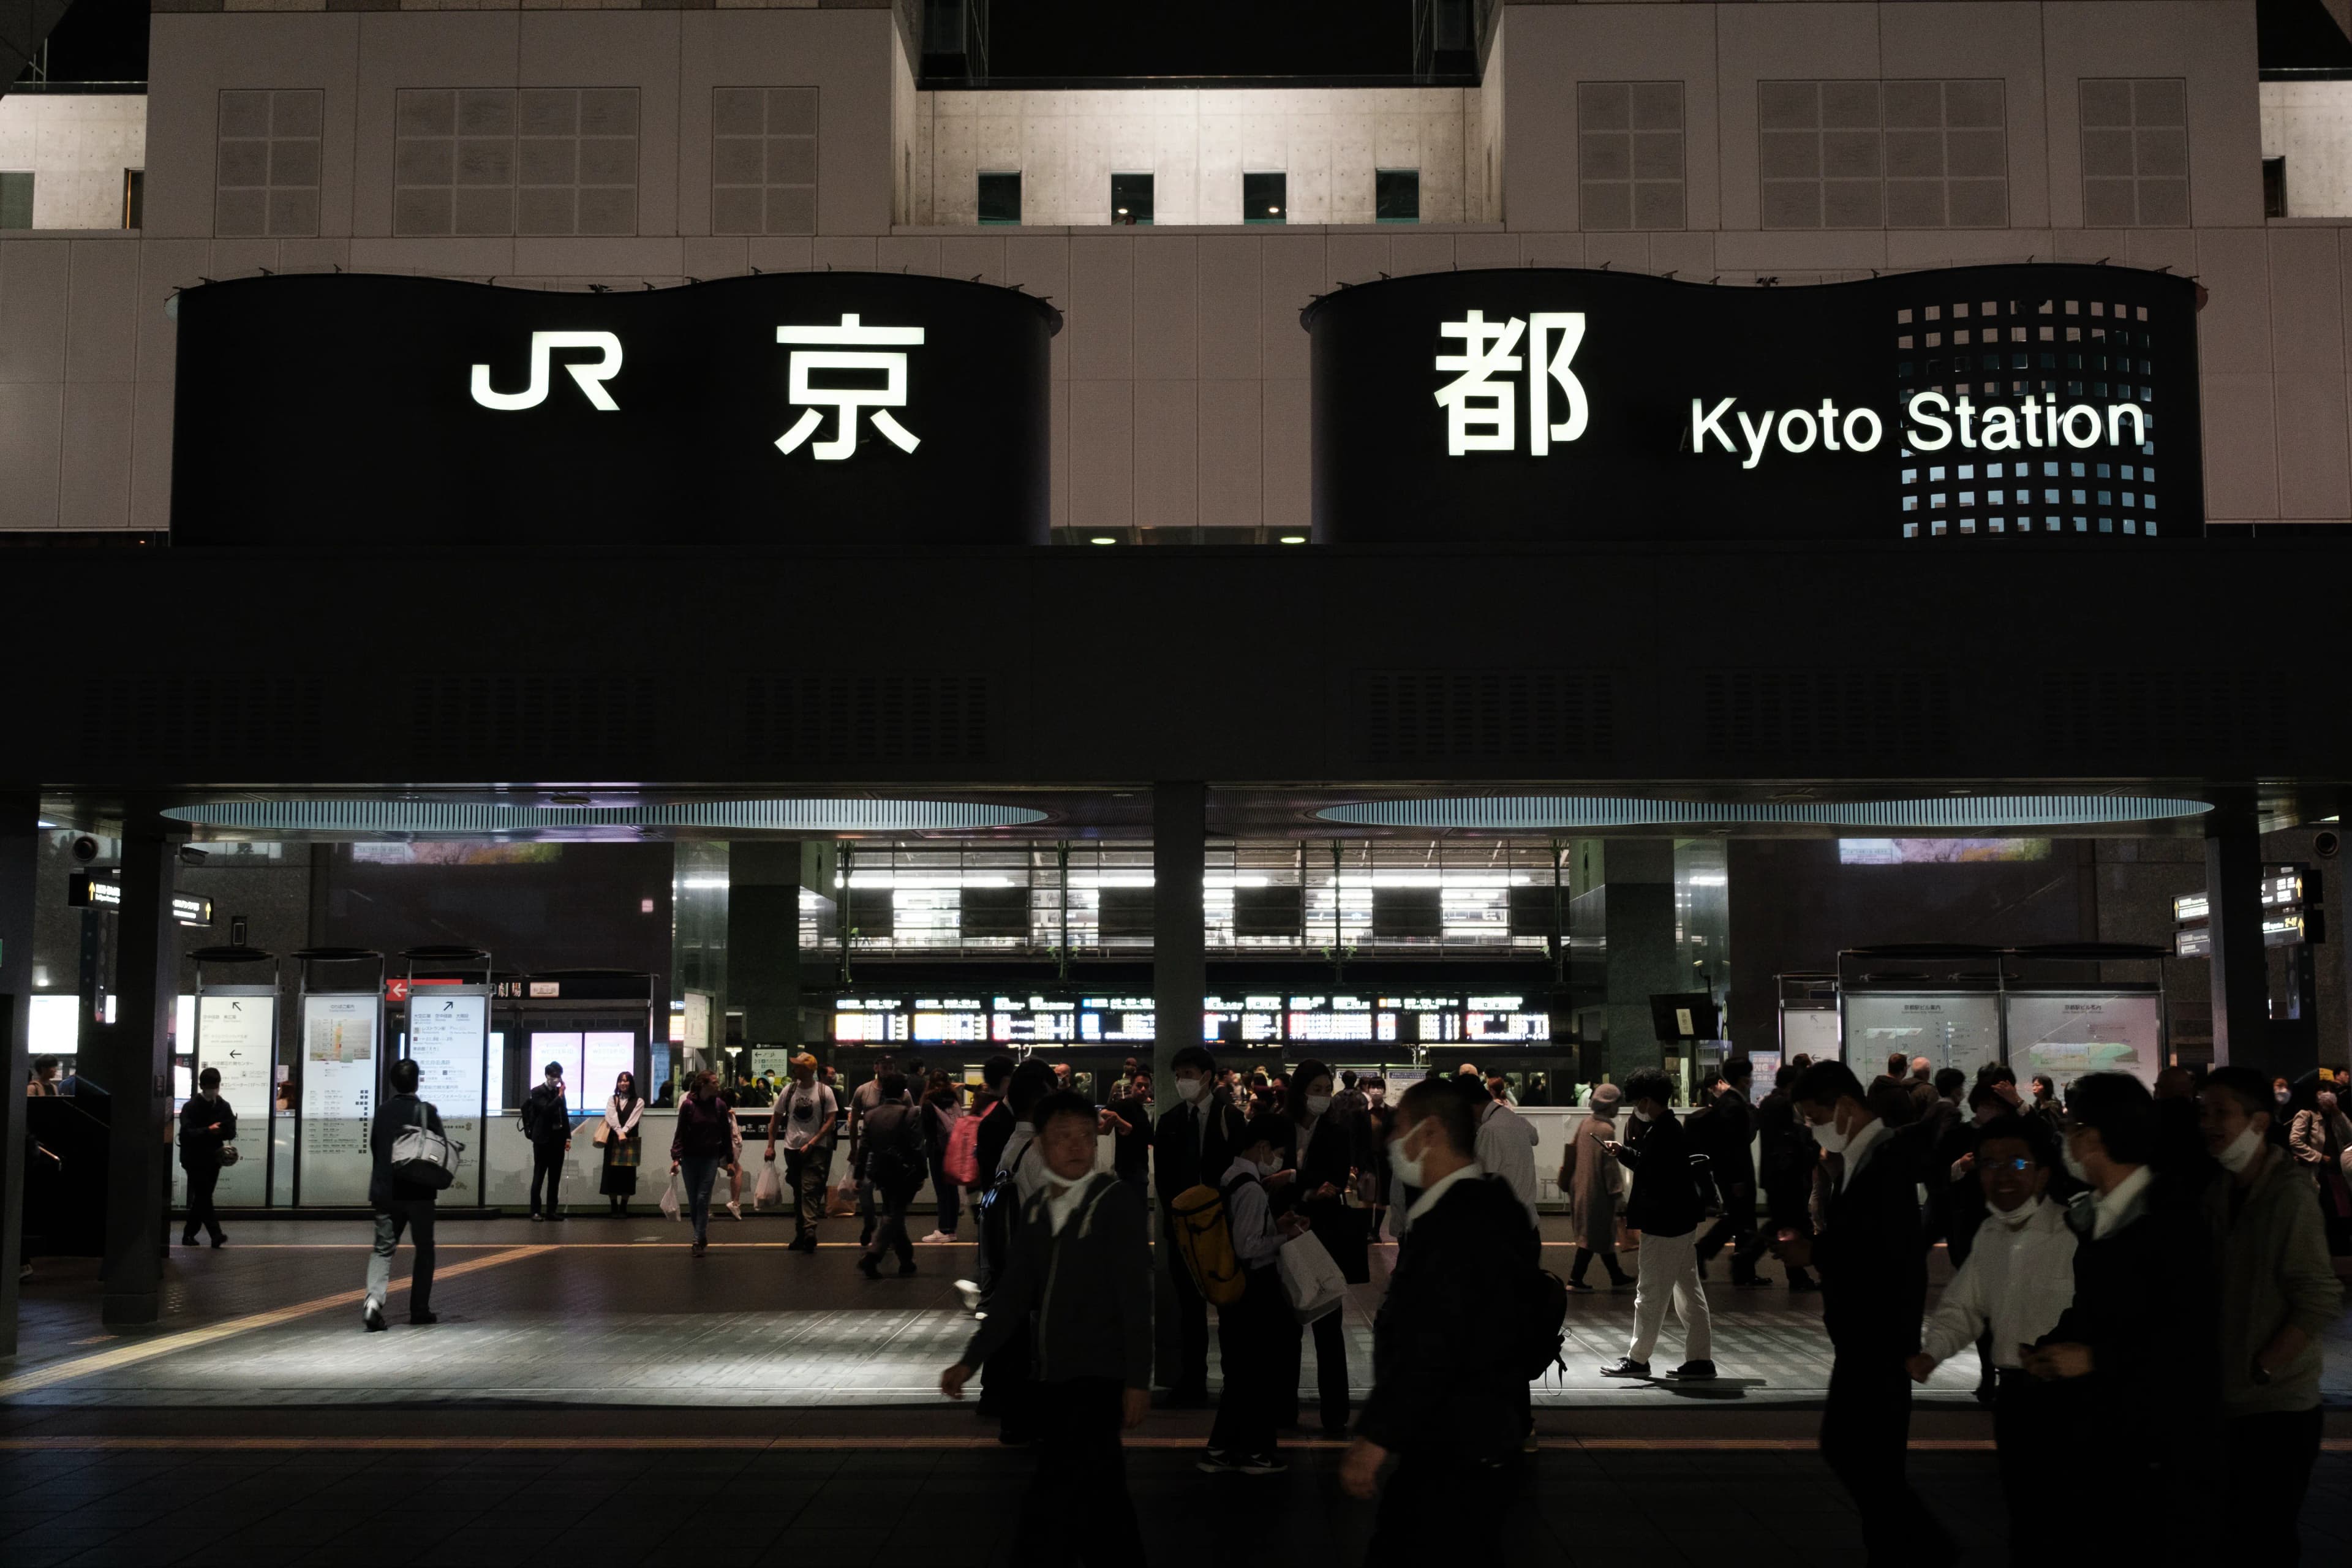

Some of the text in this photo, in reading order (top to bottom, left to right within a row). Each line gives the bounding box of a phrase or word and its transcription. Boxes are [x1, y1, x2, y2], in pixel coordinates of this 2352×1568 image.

[471, 331, 623, 410] JR
[774, 314, 924, 460] 京
[1434, 309, 1588, 456] 都
[1692, 391, 2145, 470] Kyoto Station
[498, 982, 521, 998] 劇場
